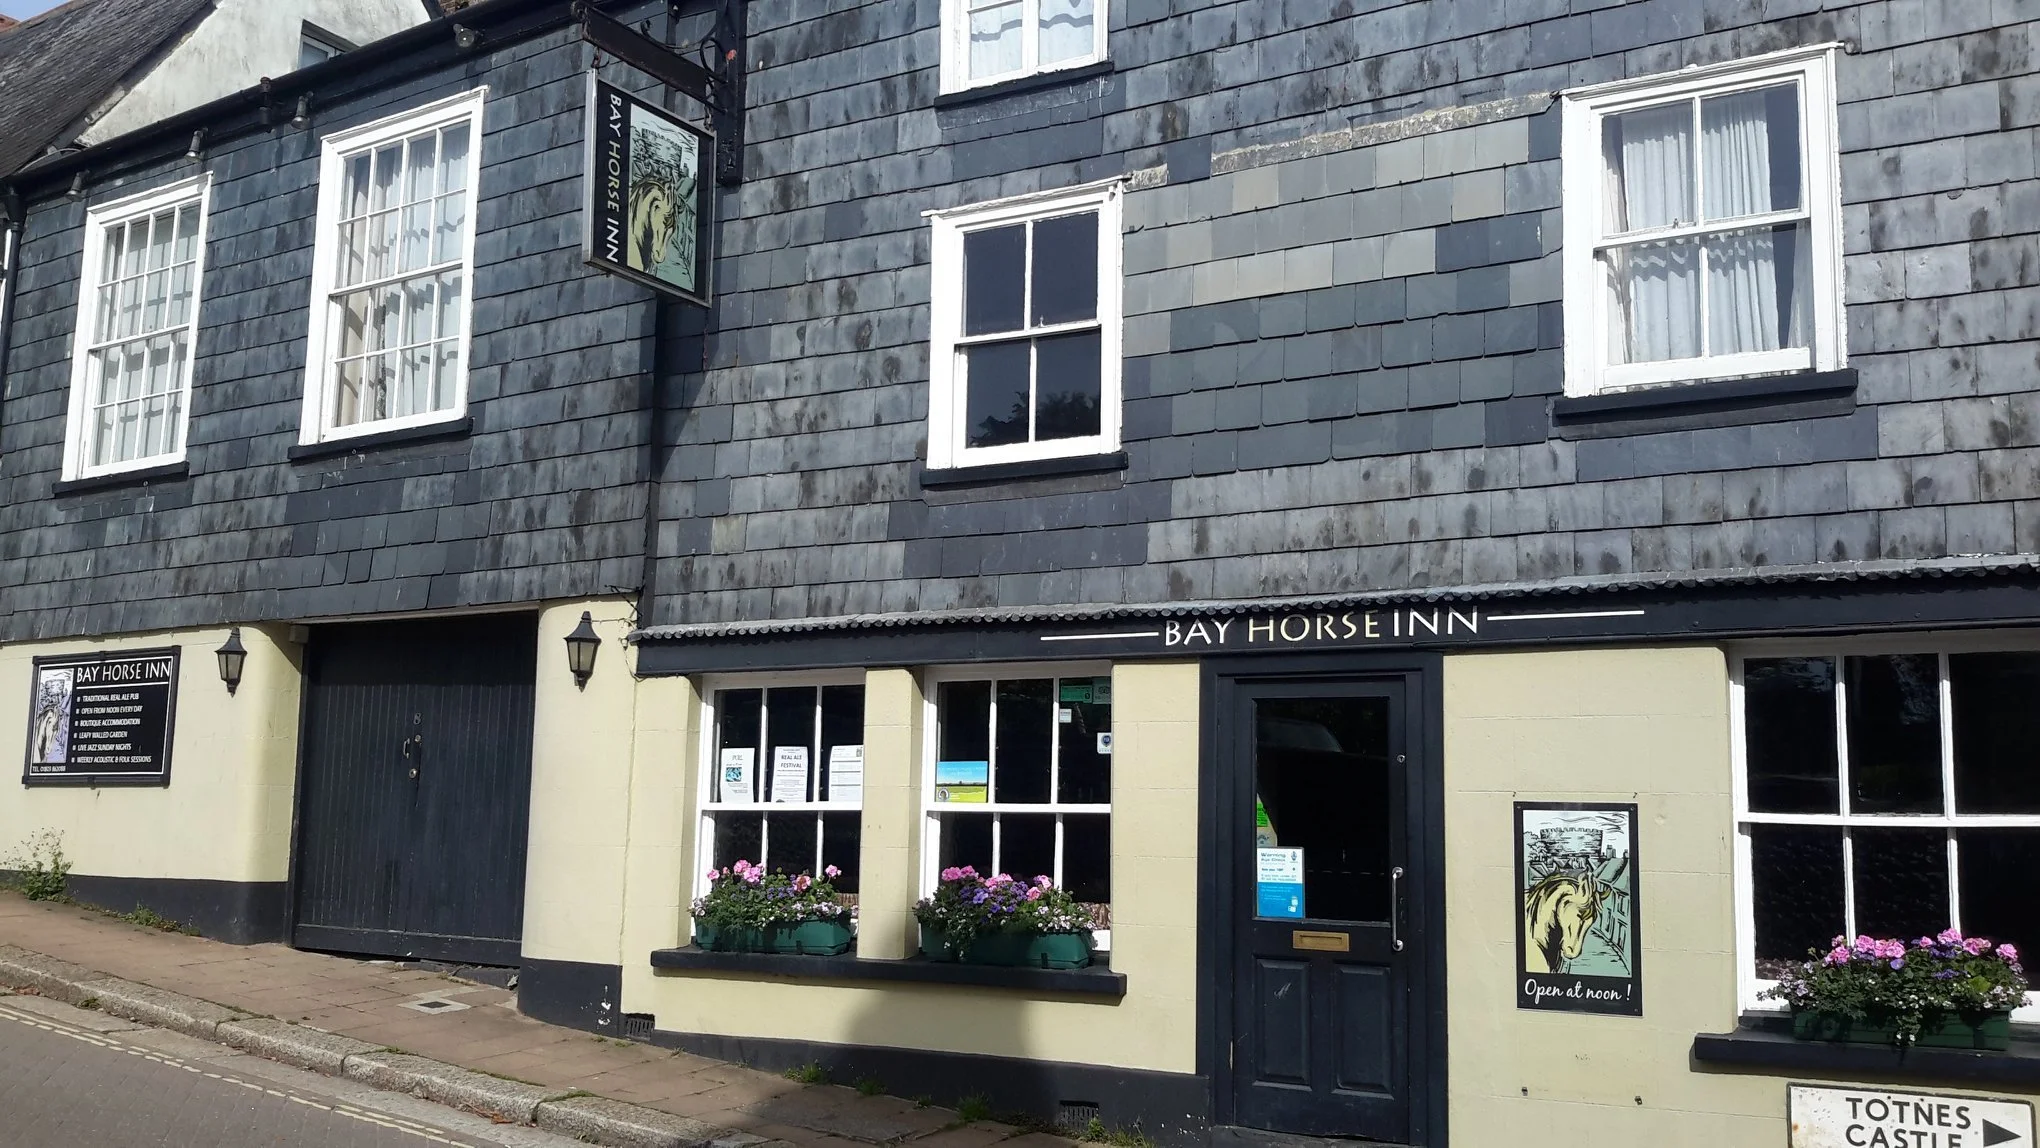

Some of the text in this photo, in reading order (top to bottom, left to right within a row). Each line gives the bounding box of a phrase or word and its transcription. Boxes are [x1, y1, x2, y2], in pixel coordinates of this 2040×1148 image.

[605, 93, 622, 263] BAY HORSE INN
[1164, 606, 1479, 646] BAY HORSE INN
[76, 661, 171, 683] BAY HORSE INN
[122, 693, 130, 701] ALE
[81, 707, 93, 715] OPEN
[106, 706, 120, 714] NOON
[133, 705, 143, 713] DAY
[102, 718, 141, 726] ACCOMMODATION
[1524, 978, 1564, 1005] Open
[1566, 981, 1583, 999] at
[1586, 986, 1622, 1001] noon
[1845, 1097, 1971, 1130] TOTNES
